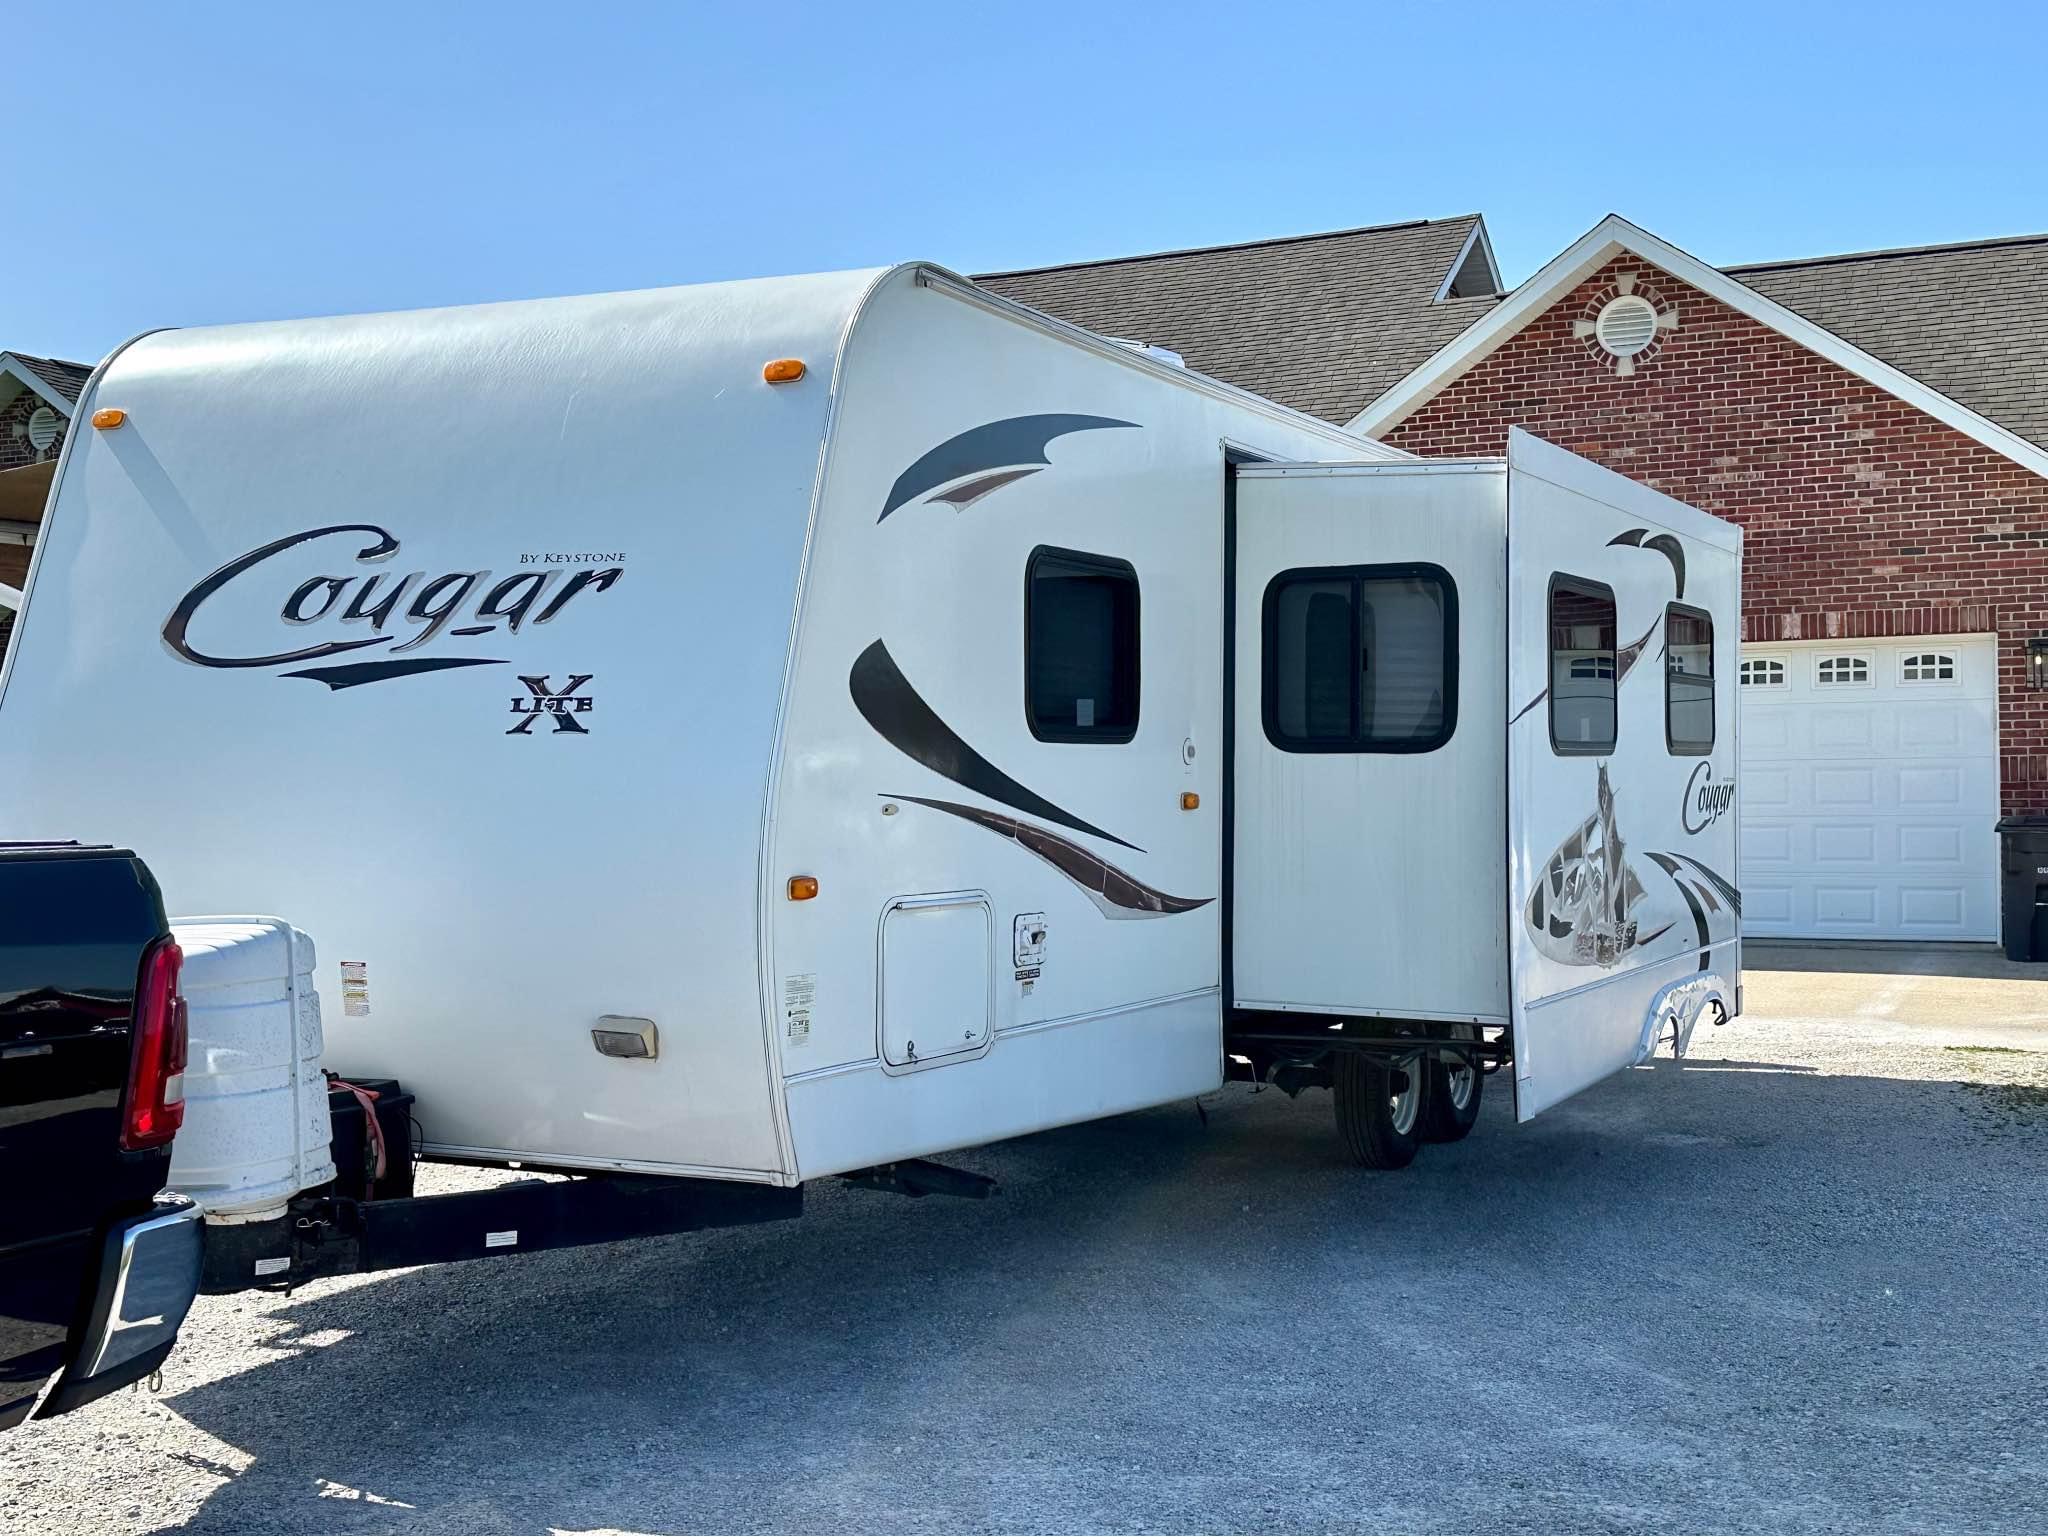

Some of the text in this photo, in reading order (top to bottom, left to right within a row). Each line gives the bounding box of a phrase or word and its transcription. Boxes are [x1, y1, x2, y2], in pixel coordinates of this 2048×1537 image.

[520, 552, 627, 563] BY KEYSTONE
[160, 523, 625, 668] Cougar
[510, 696, 593, 713] LITE
[1682, 760, 1735, 836] Cougar
